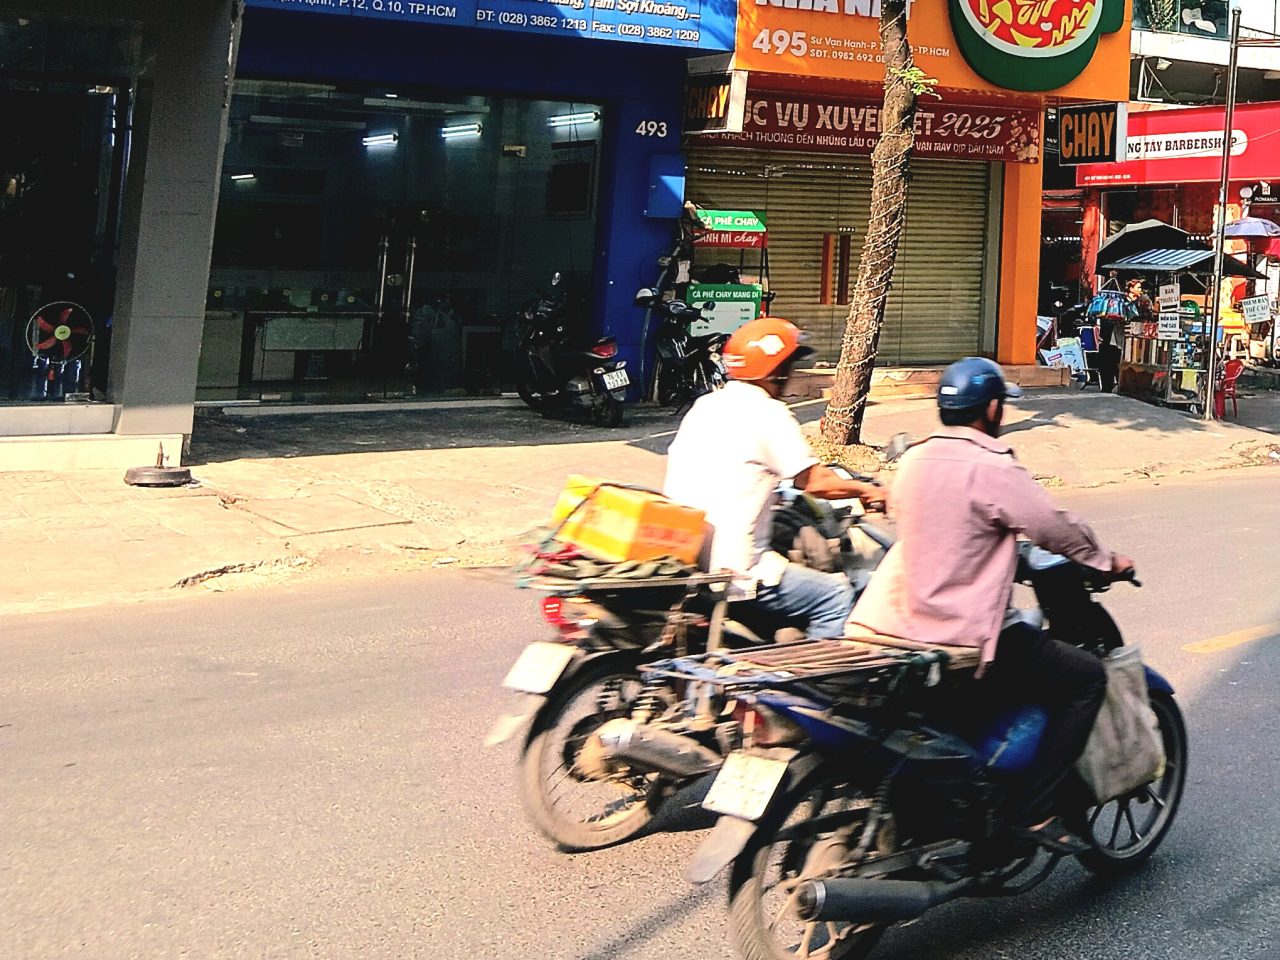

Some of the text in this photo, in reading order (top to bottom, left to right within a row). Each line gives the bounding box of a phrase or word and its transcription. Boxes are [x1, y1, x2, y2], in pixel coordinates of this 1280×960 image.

[372, 0, 405, 15] Q.10,
[408, 2, 457, 18] TP.HCM
[476, 9, 495, 22] ĐT:
[498, 10, 528, 27] (028)
[530, 15, 557, 28] 3862
[561, 18, 587, 31] 1213
[592, 20, 616, 33] Fax:
[617, 22, 645, 38] (028)
[647, 26, 673, 39] 3862
[675, 28, 700, 41] 1209
[751, 27, 809, 58] 495
[810, 34, 823, 45] Sư
[825, 37, 843, 49] Vạn
[635, 120, 668, 138] 493
[775, 102, 810, 131] VỤ
[933, 112, 1007, 139] 2025
[1061, 111, 1115, 159] CHAY
[1165, 136, 1238, 152] BARBERSHP
[734, 216, 759, 227] CHAY
[734, 231, 760, 245] chay
